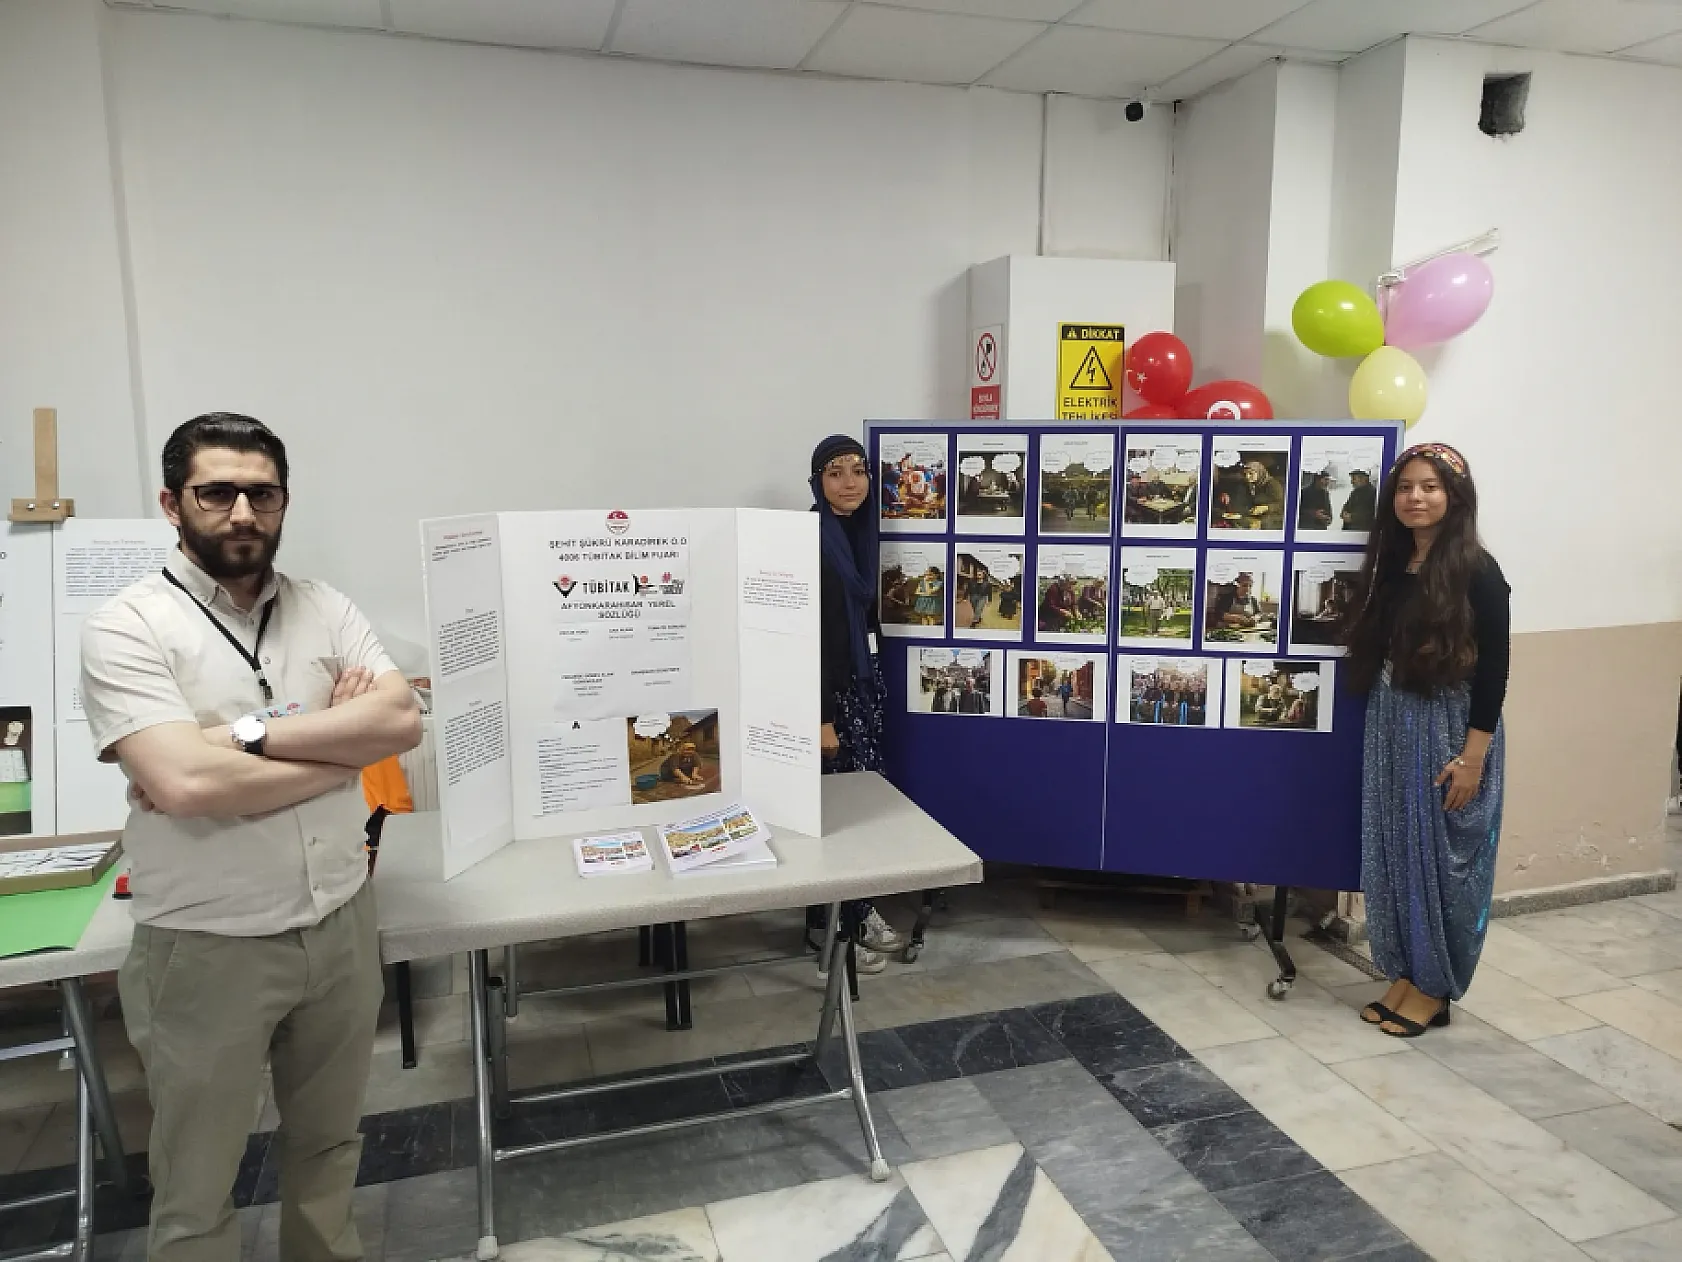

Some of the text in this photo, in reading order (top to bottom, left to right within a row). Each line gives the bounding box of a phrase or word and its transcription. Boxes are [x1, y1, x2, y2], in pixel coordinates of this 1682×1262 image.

[1081, 327, 1120, 340] DİKKAT
[1063, 396, 1118, 408] ELEKTRİK
[625, 550, 650, 559] BİLİM
[582, 580, 630, 594] TÜBİTAK
